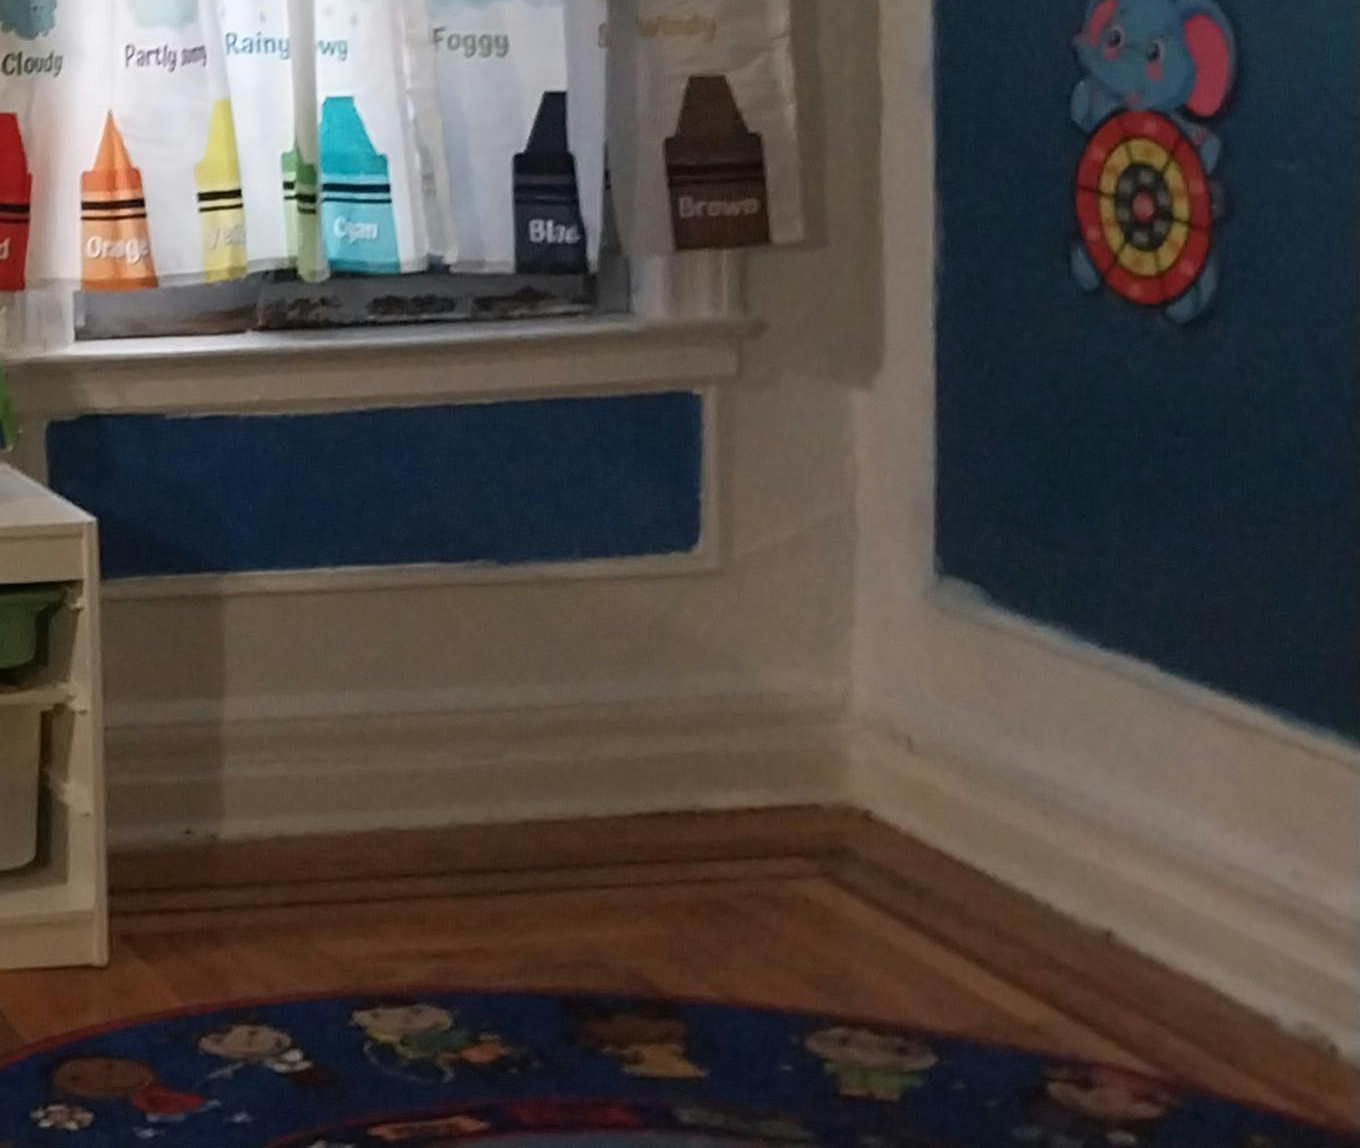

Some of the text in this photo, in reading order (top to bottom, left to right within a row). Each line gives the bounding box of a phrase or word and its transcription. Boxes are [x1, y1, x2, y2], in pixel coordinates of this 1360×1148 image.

[224, 32, 292, 61] Rainy
[432, 25, 511, 58] Foggy
[0, 49, 65, 77] Cloudy
[124, 44, 177, 73] Partly
